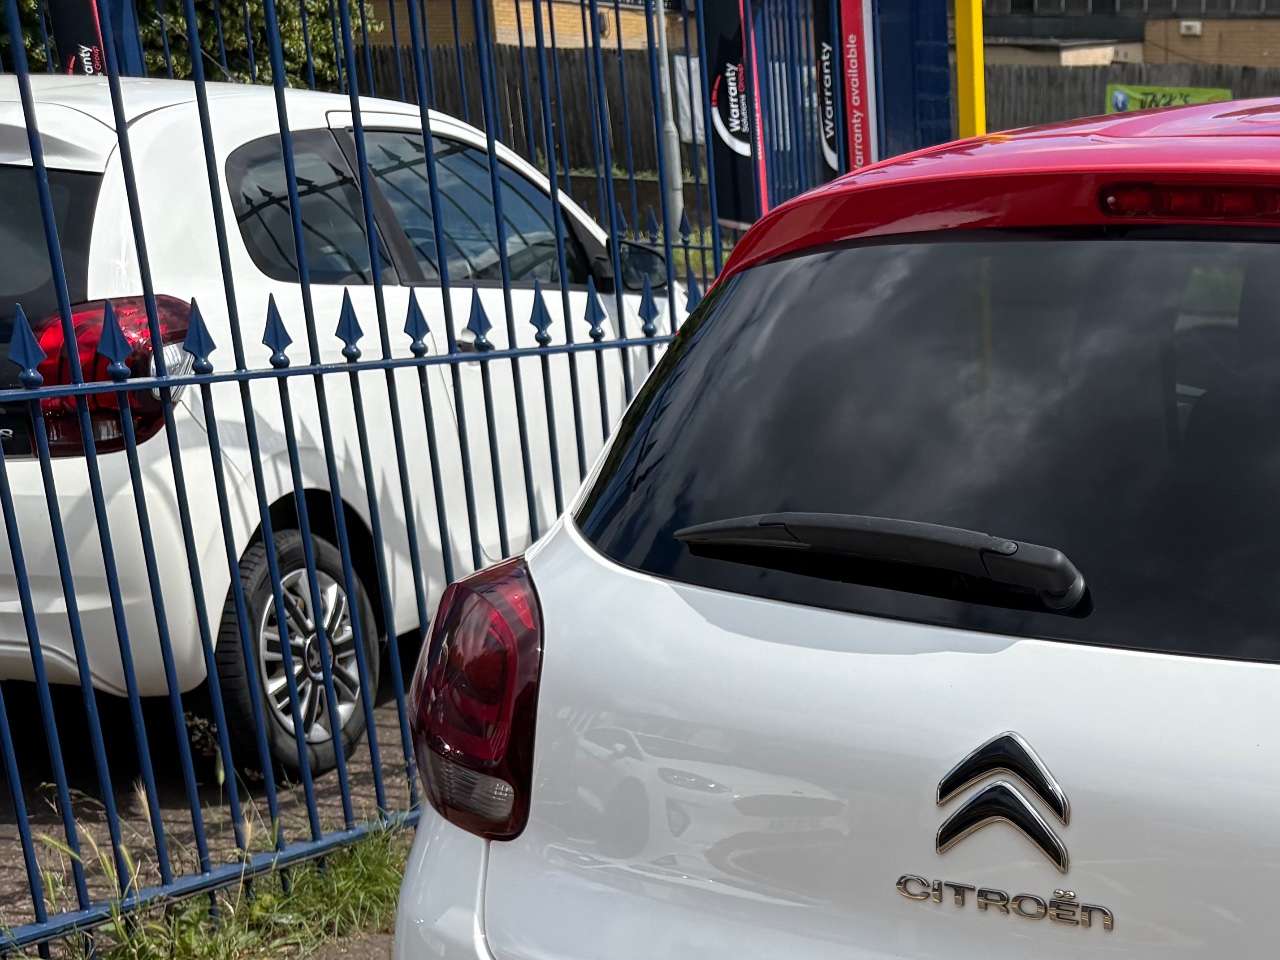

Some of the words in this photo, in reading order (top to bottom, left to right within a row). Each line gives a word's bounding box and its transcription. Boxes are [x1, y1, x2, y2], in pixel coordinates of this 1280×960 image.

[725, 62, 741, 133] Warranty
[821, 42, 835, 139] Warranty
[847, 34, 860, 106] available
